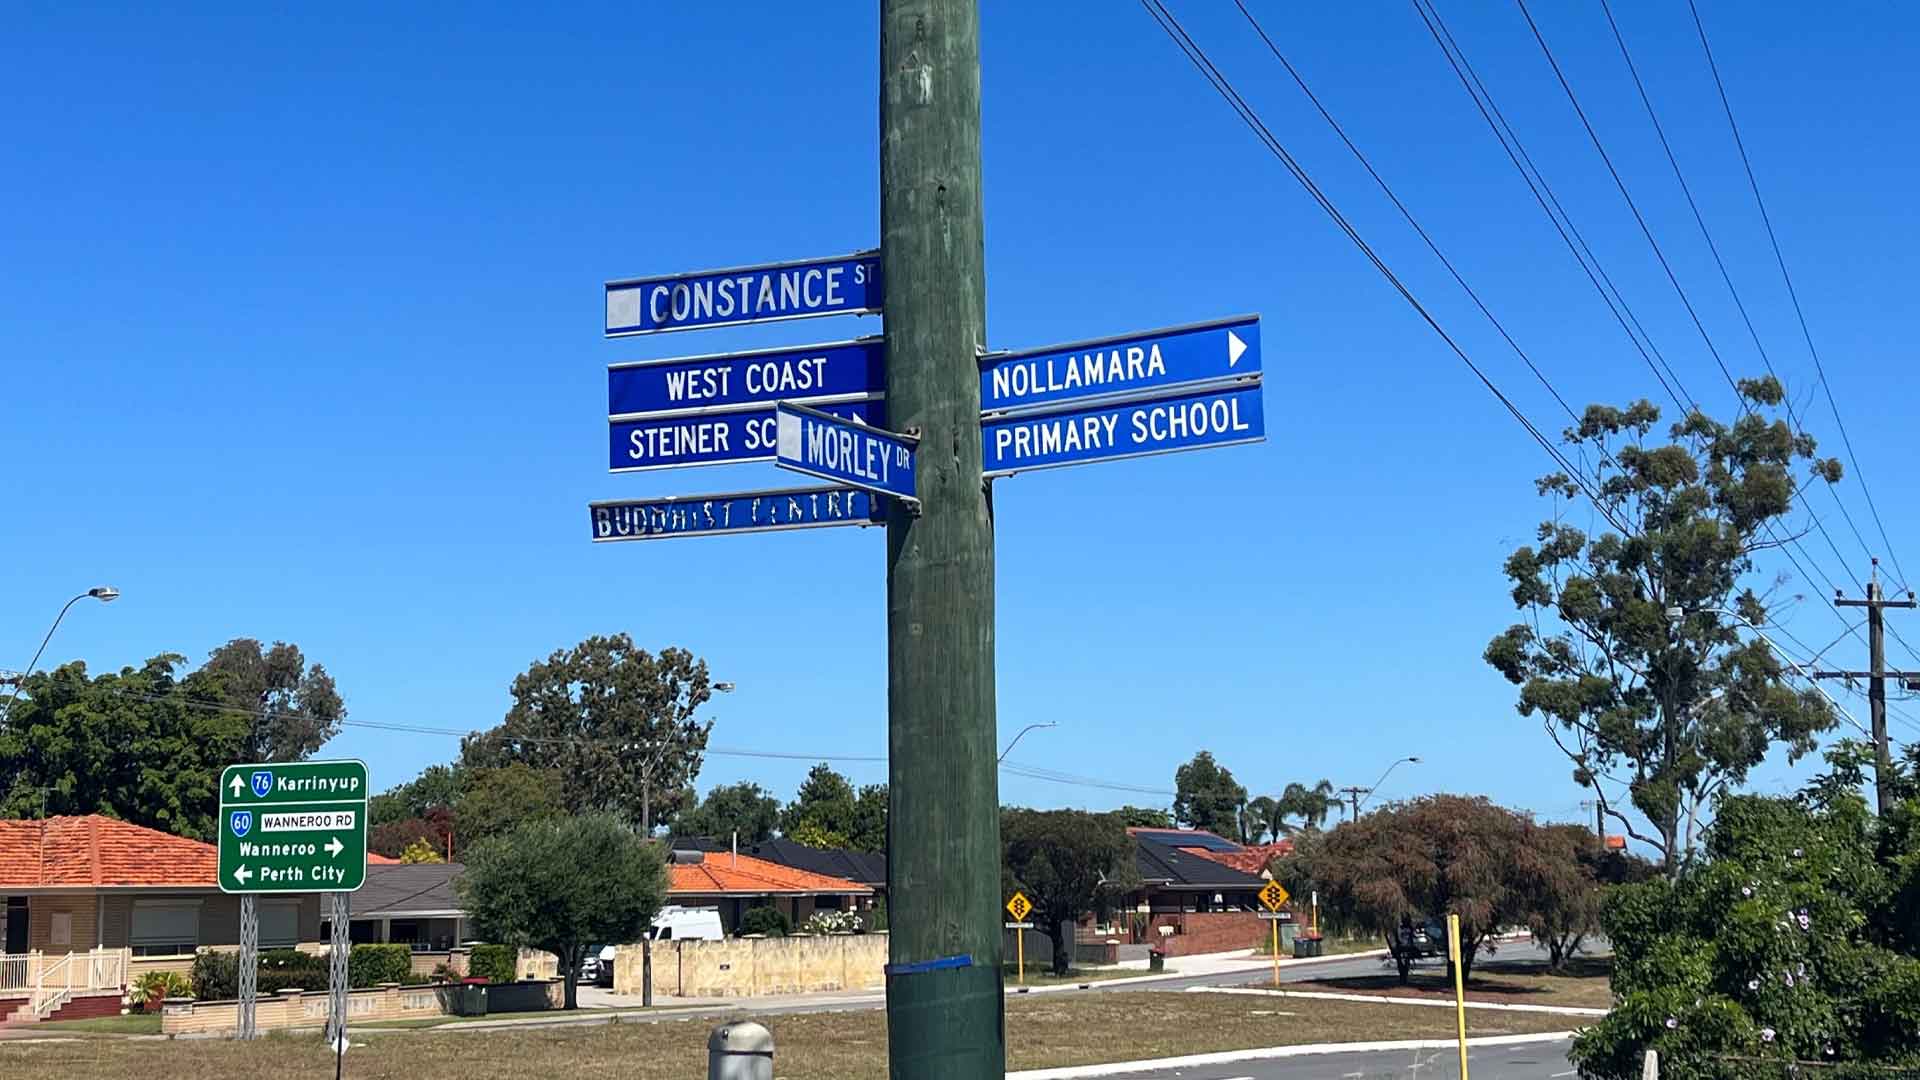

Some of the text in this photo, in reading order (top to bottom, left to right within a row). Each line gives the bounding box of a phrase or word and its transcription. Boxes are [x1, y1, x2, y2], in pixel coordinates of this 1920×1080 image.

[650, 264, 875, 323] CONSTANCE ST
[666, 358, 827, 400] WEST COAST
[992, 344, 1166, 399] NOLLAMARA
[629, 423, 729, 459] STEINER
[996, 398, 1249, 461] PRIMARY SCHOOL
[808, 421, 891, 482] MORLEY
[896, 446, 910, 470] DR
[597, 501, 733, 537] BUDDHIST
[255, 775, 269, 787] 76
[277, 776, 359, 792] Karrinyup
[234, 815, 249, 830] 60
[264, 815, 353, 829] WANNEROO RD
[240, 842, 316, 857] Wanneroo
[261, 865, 345, 884] Perth City
